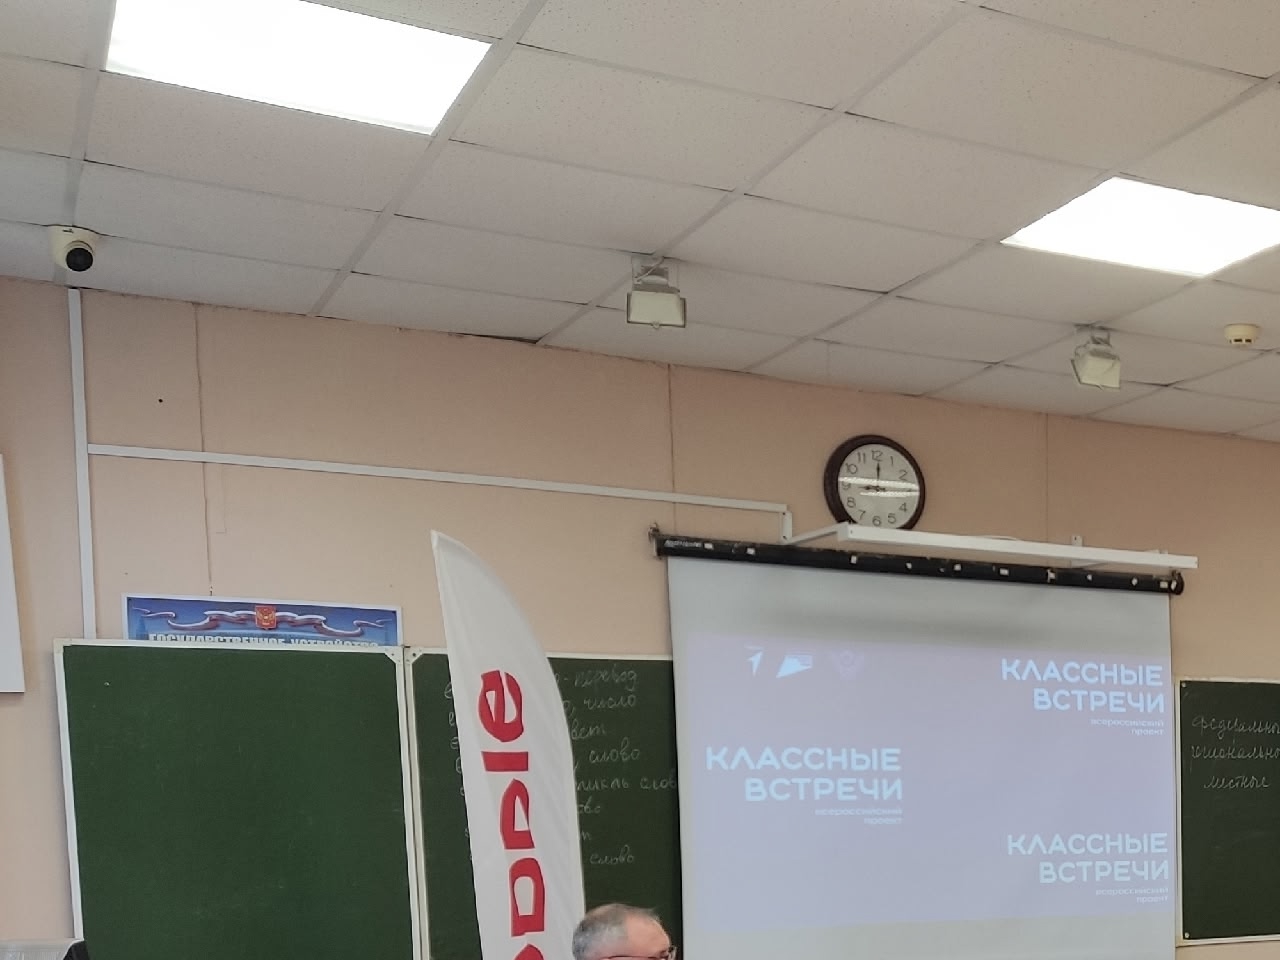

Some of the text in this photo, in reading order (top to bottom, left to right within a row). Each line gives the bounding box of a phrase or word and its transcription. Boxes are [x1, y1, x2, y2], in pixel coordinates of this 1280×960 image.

[871, 450, 883, 462] 12
[845, 462, 858, 475] 10
[898, 469, 908, 481] 2
[846, 497, 856, 508] 8
[898, 502, 908, 513] 4
[858, 509, 867, 520] 7
[887, 512, 897, 524] 5
[872, 515, 882, 527] 6
[1001, 658, 1164, 687] КЛАССНЫЕ
[1033, 687, 1165, 713] ВСТРЕЧИ
[706, 746, 902, 771] КЛАССНЫЕ
[744, 777, 903, 801] ВСТРЕЧИ
[1007, 832, 1169, 856] КЛАССНЫЕ
[1039, 860, 1170, 884] ВСТРЕЧИ
